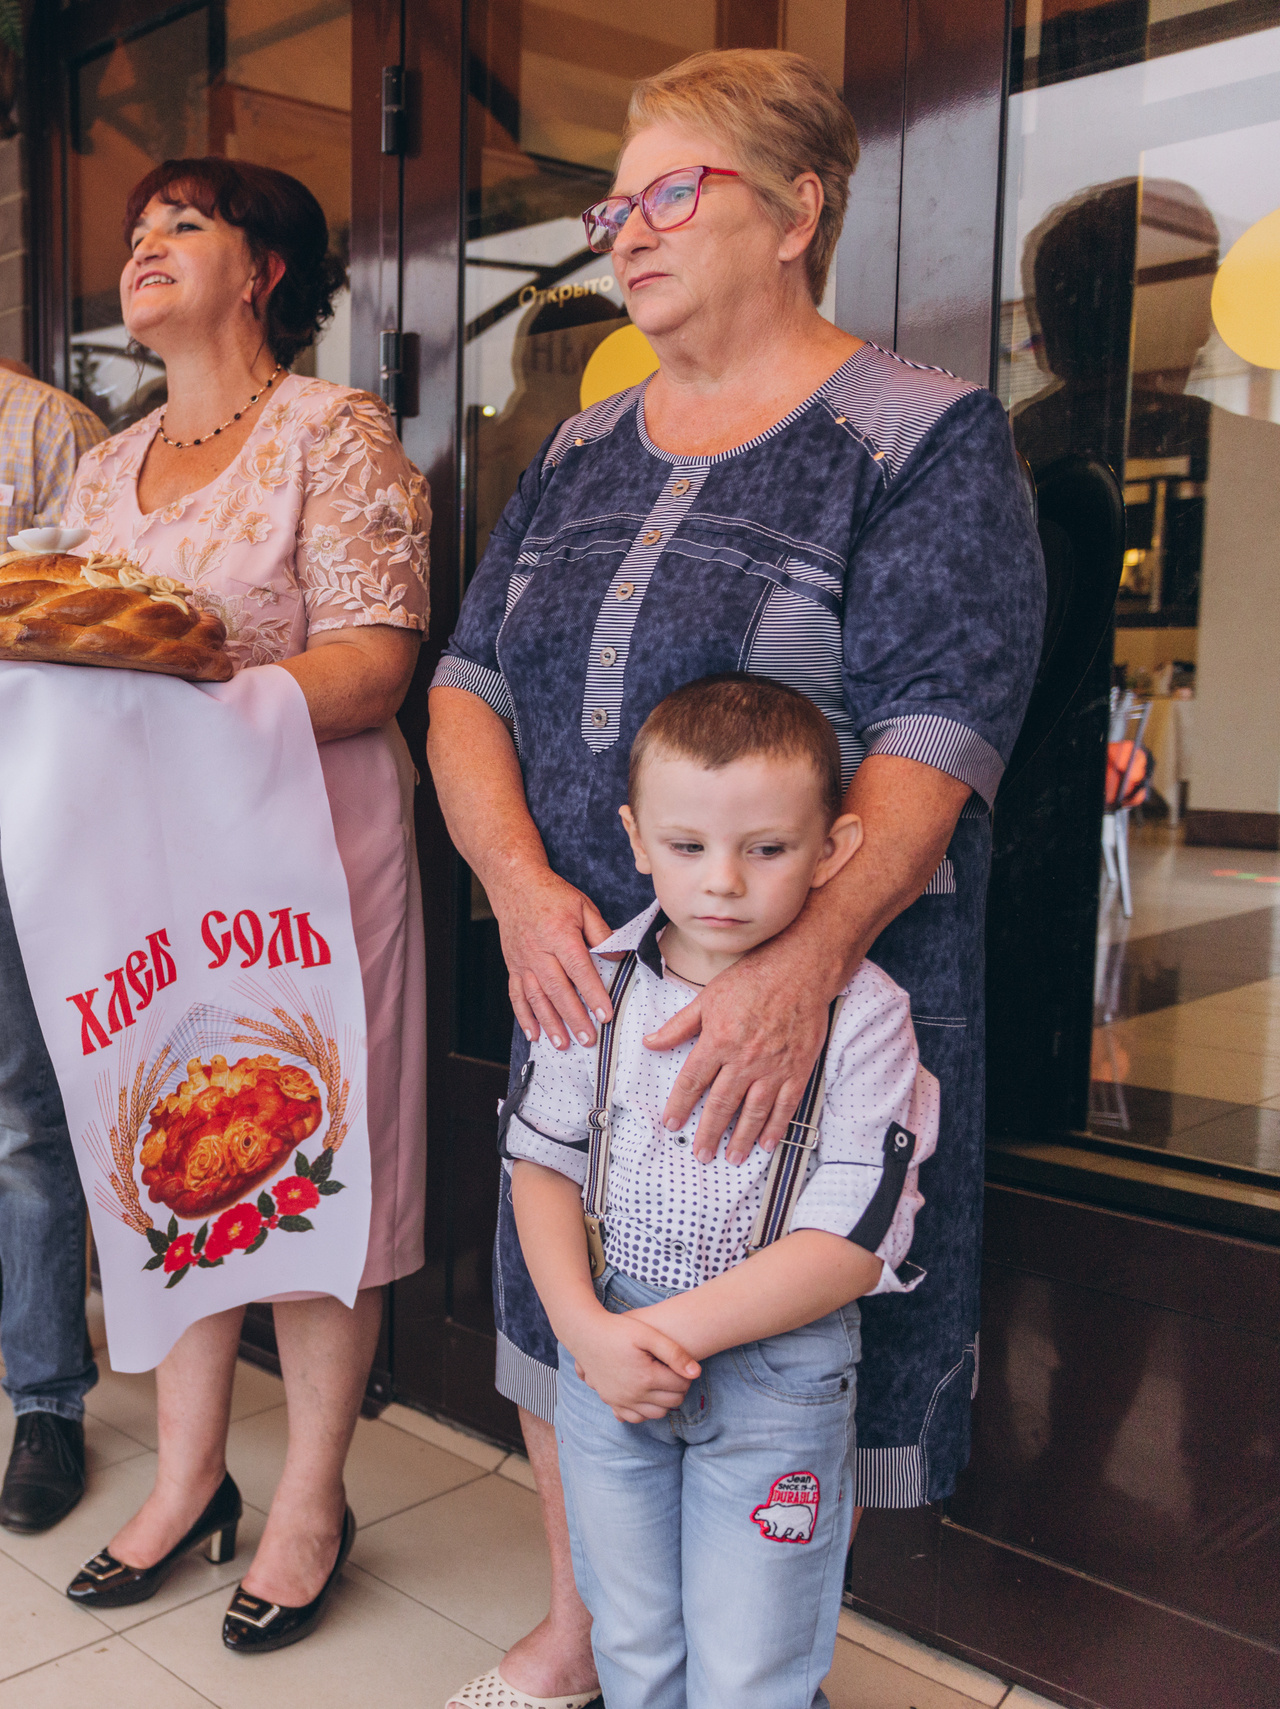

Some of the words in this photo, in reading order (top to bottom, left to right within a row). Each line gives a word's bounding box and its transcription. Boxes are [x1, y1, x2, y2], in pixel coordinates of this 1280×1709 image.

[519, 275, 614, 308] Открыто
[201, 907, 331, 969] СОЛЬ
[786, 1475, 812, 1484] Jean
[773, 1490, 818, 1504] DURABLE
